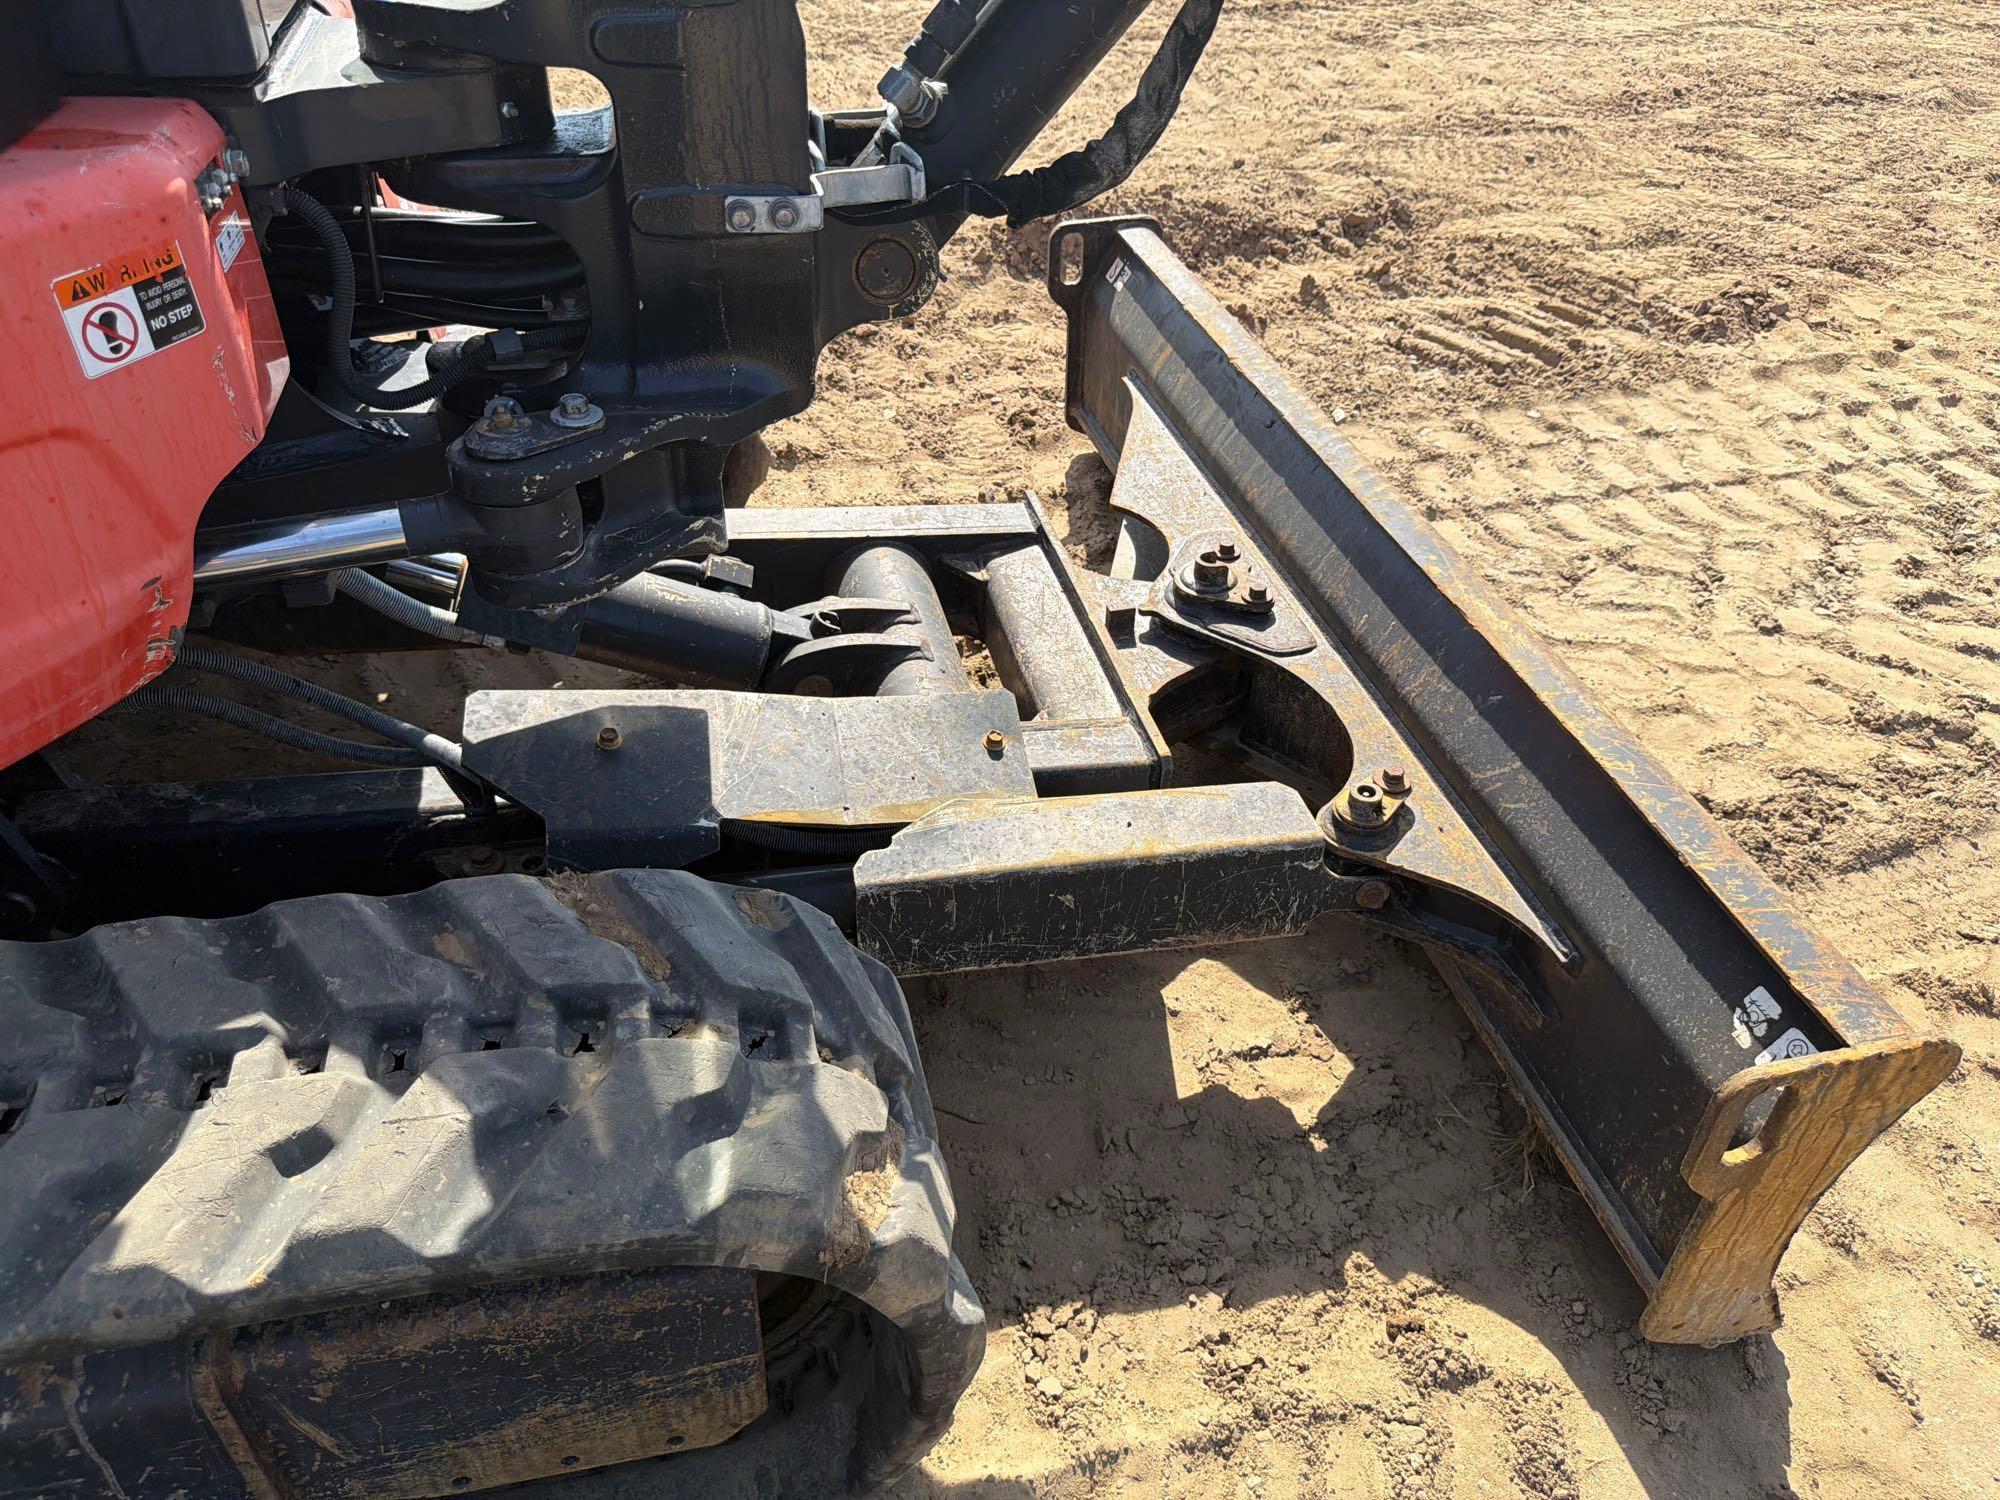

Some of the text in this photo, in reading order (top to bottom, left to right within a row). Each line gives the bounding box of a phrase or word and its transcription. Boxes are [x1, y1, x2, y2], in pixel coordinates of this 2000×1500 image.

[138, 276, 186, 301] TO AVOID PERSONAL
[145, 297, 162, 311] INJURY
[163, 294, 172, 304] OR
[150, 303, 193, 331] NO STEP
